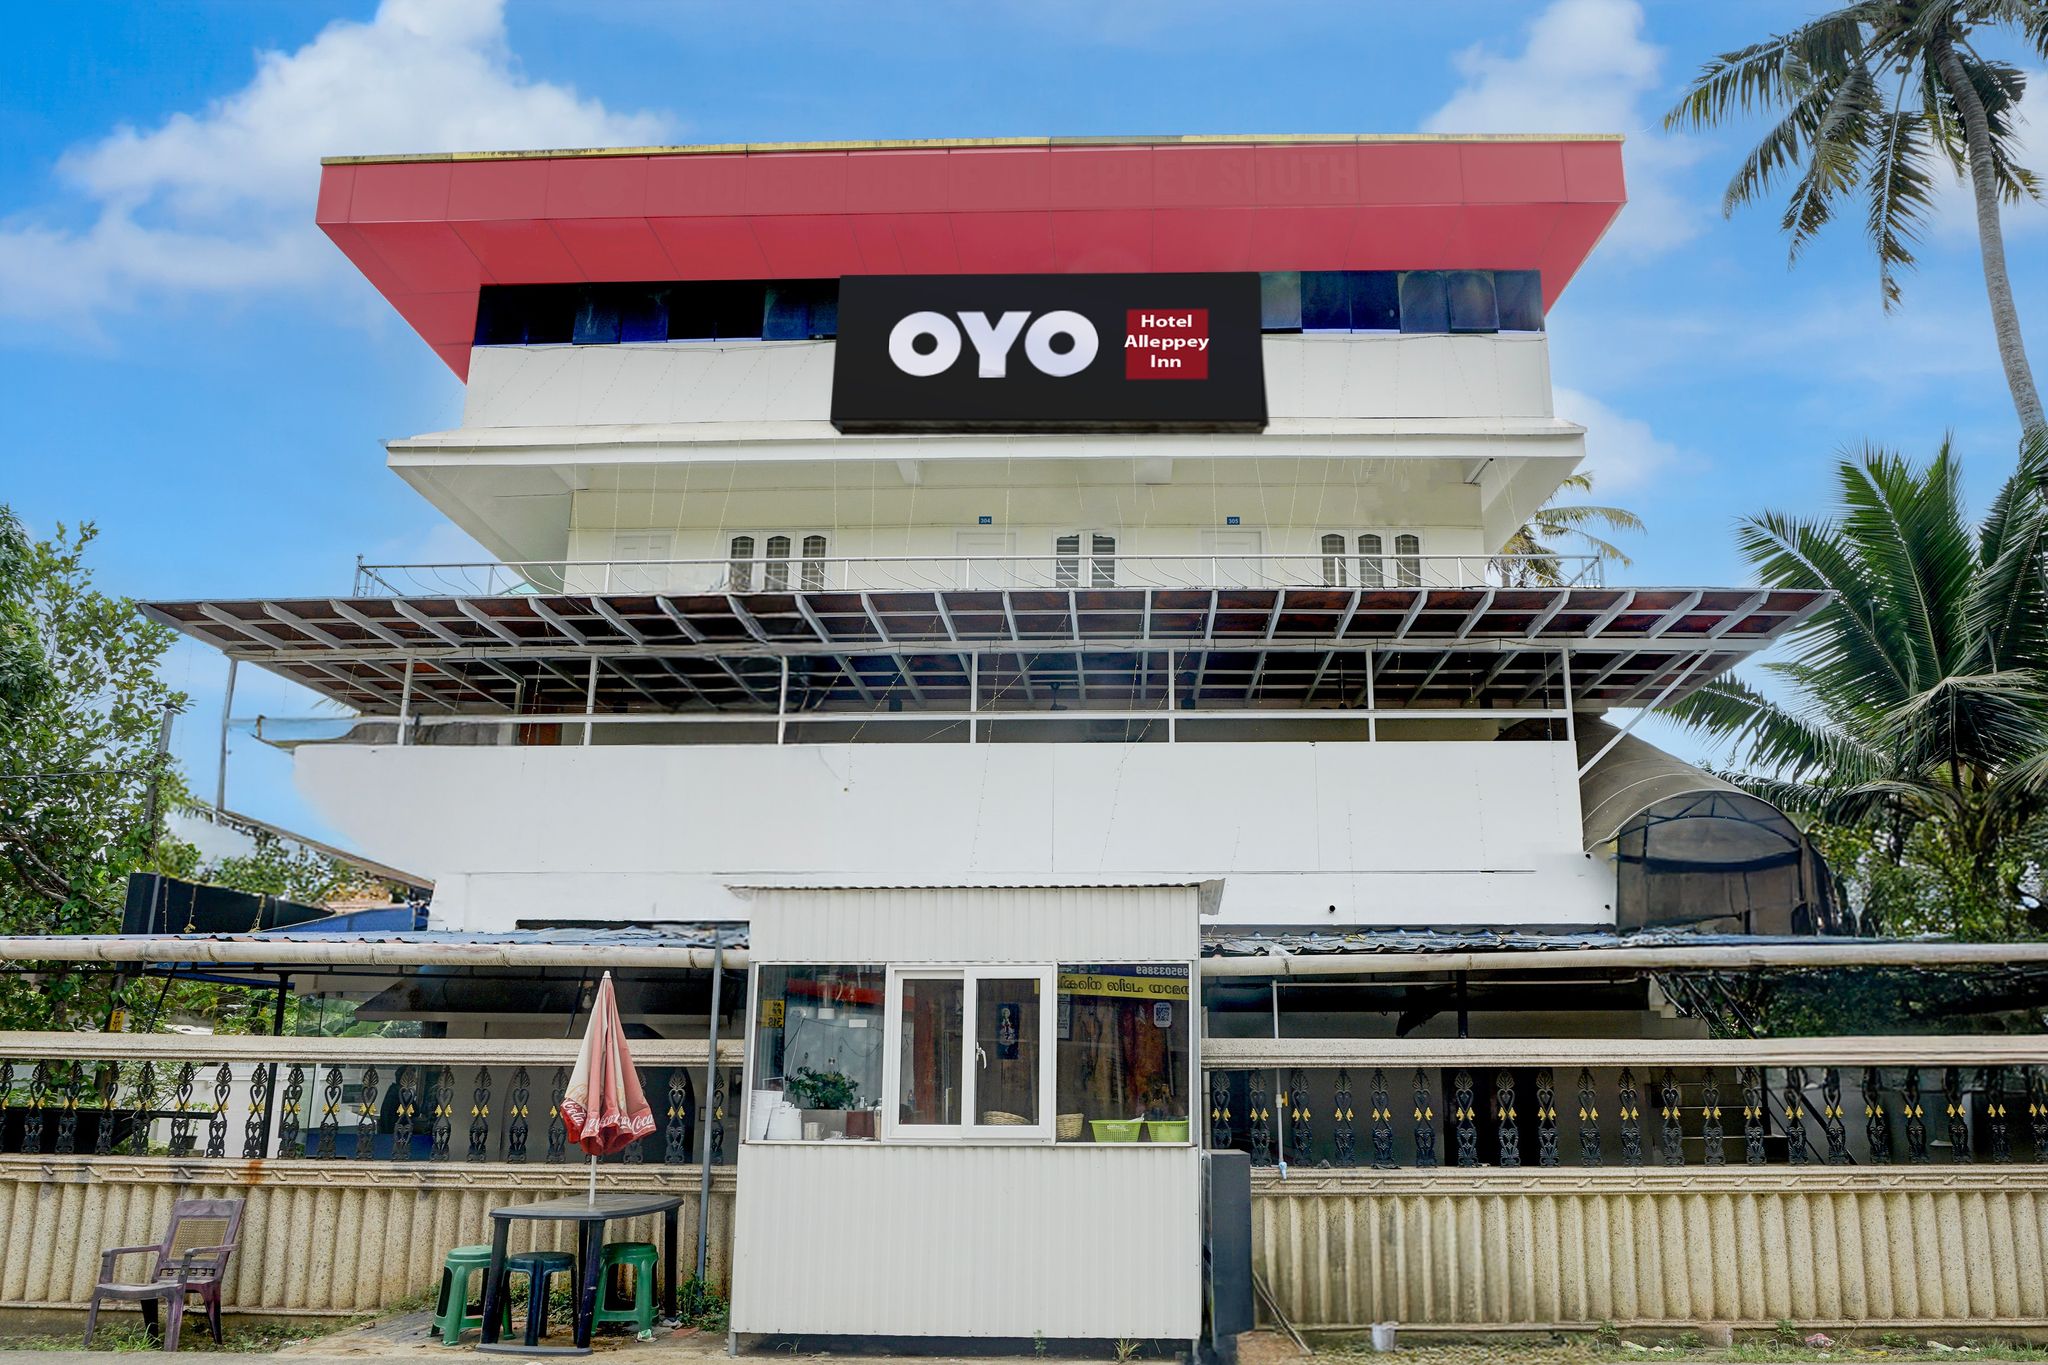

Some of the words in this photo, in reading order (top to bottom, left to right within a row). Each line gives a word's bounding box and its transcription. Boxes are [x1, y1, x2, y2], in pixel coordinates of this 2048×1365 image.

[1218, 154, 1358, 197] SOUTH
[1140, 315, 1193, 329] Hotel
[888, 310, 1099, 379] OYO
[1124, 334, 1210, 351] Alleppey
[1150, 355, 1182, 368] Inn
[632, 1115, 655, 1134] Coca
